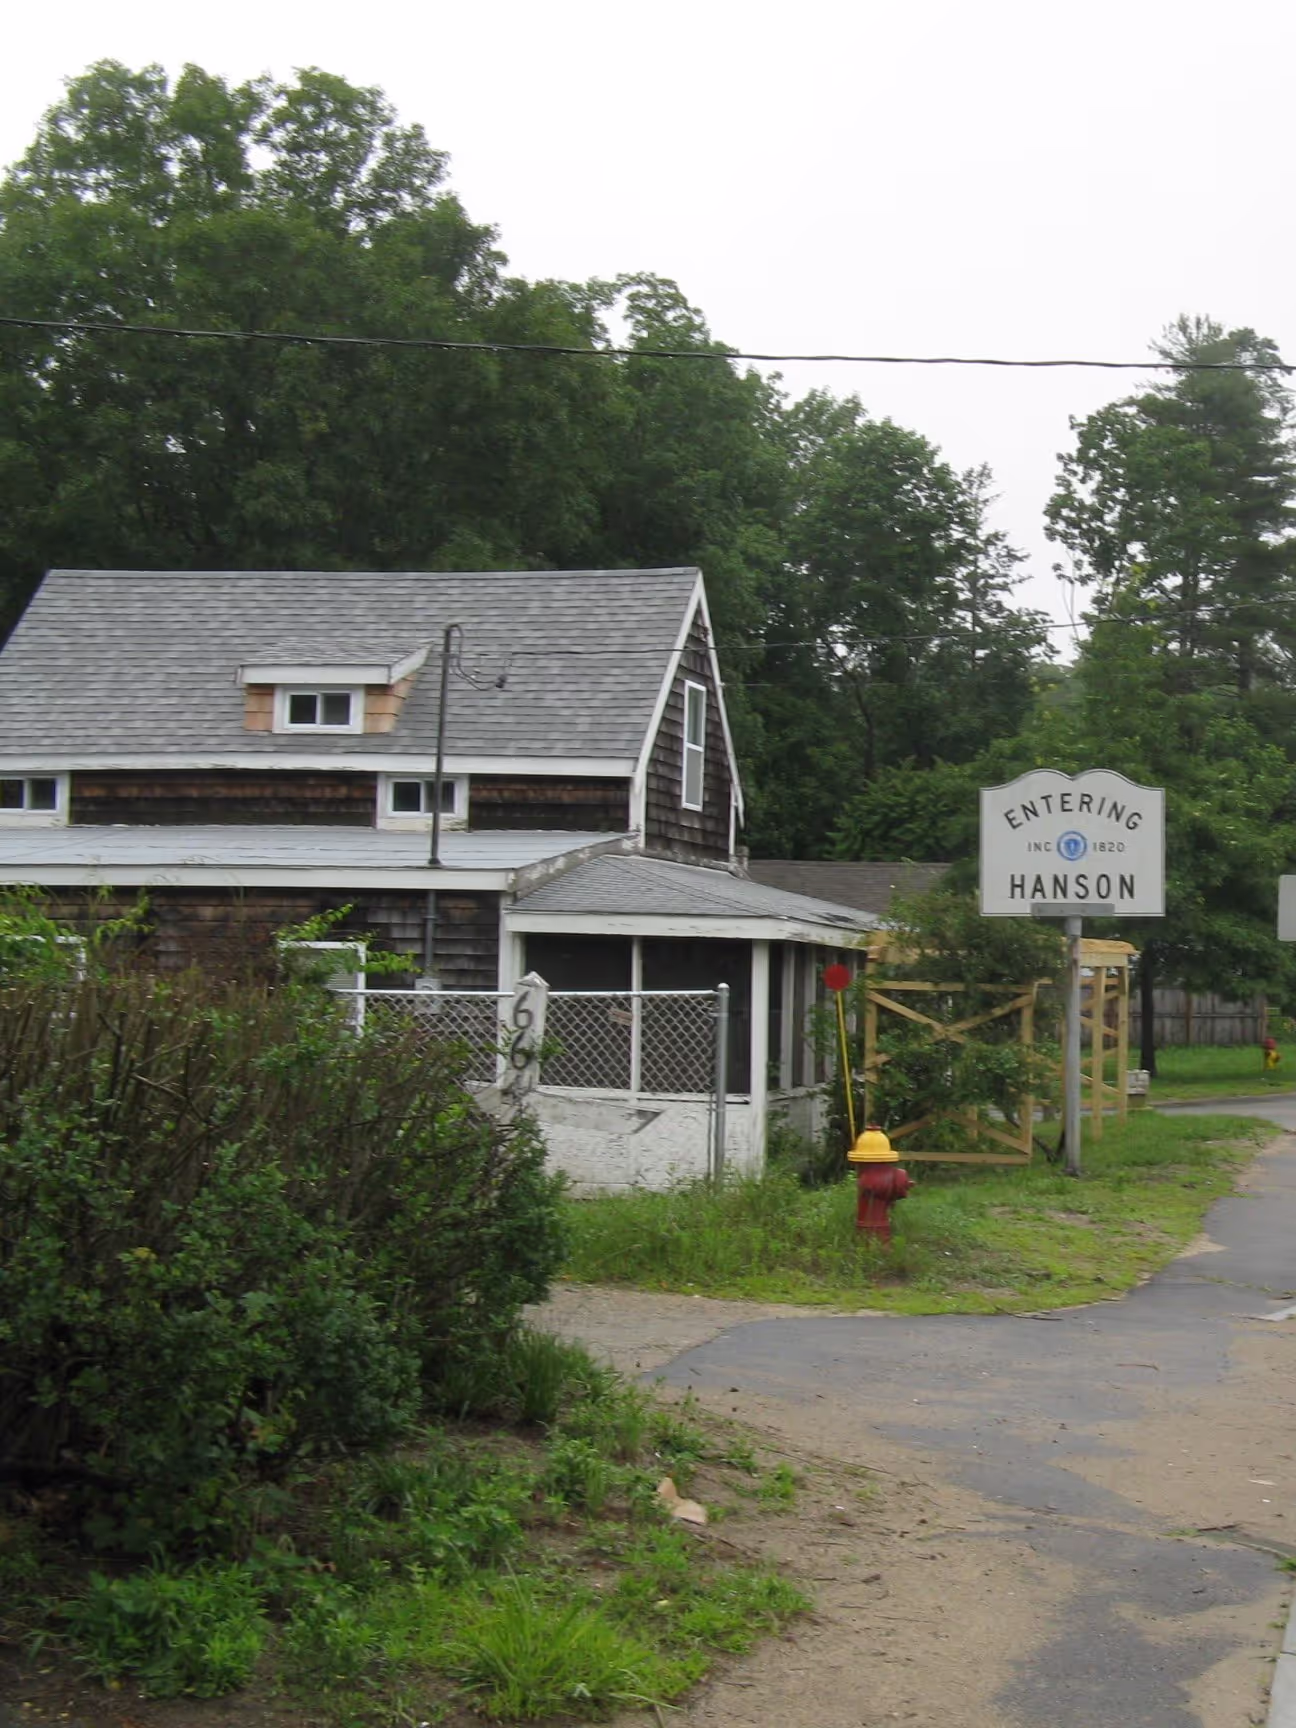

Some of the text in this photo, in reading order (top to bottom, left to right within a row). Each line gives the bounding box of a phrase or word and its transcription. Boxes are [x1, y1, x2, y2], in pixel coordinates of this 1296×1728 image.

[1003, 792, 1143, 831] ENTERING
[1028, 841, 1125, 853] INC 1820
[1010, 873, 1136, 900] HANSON
